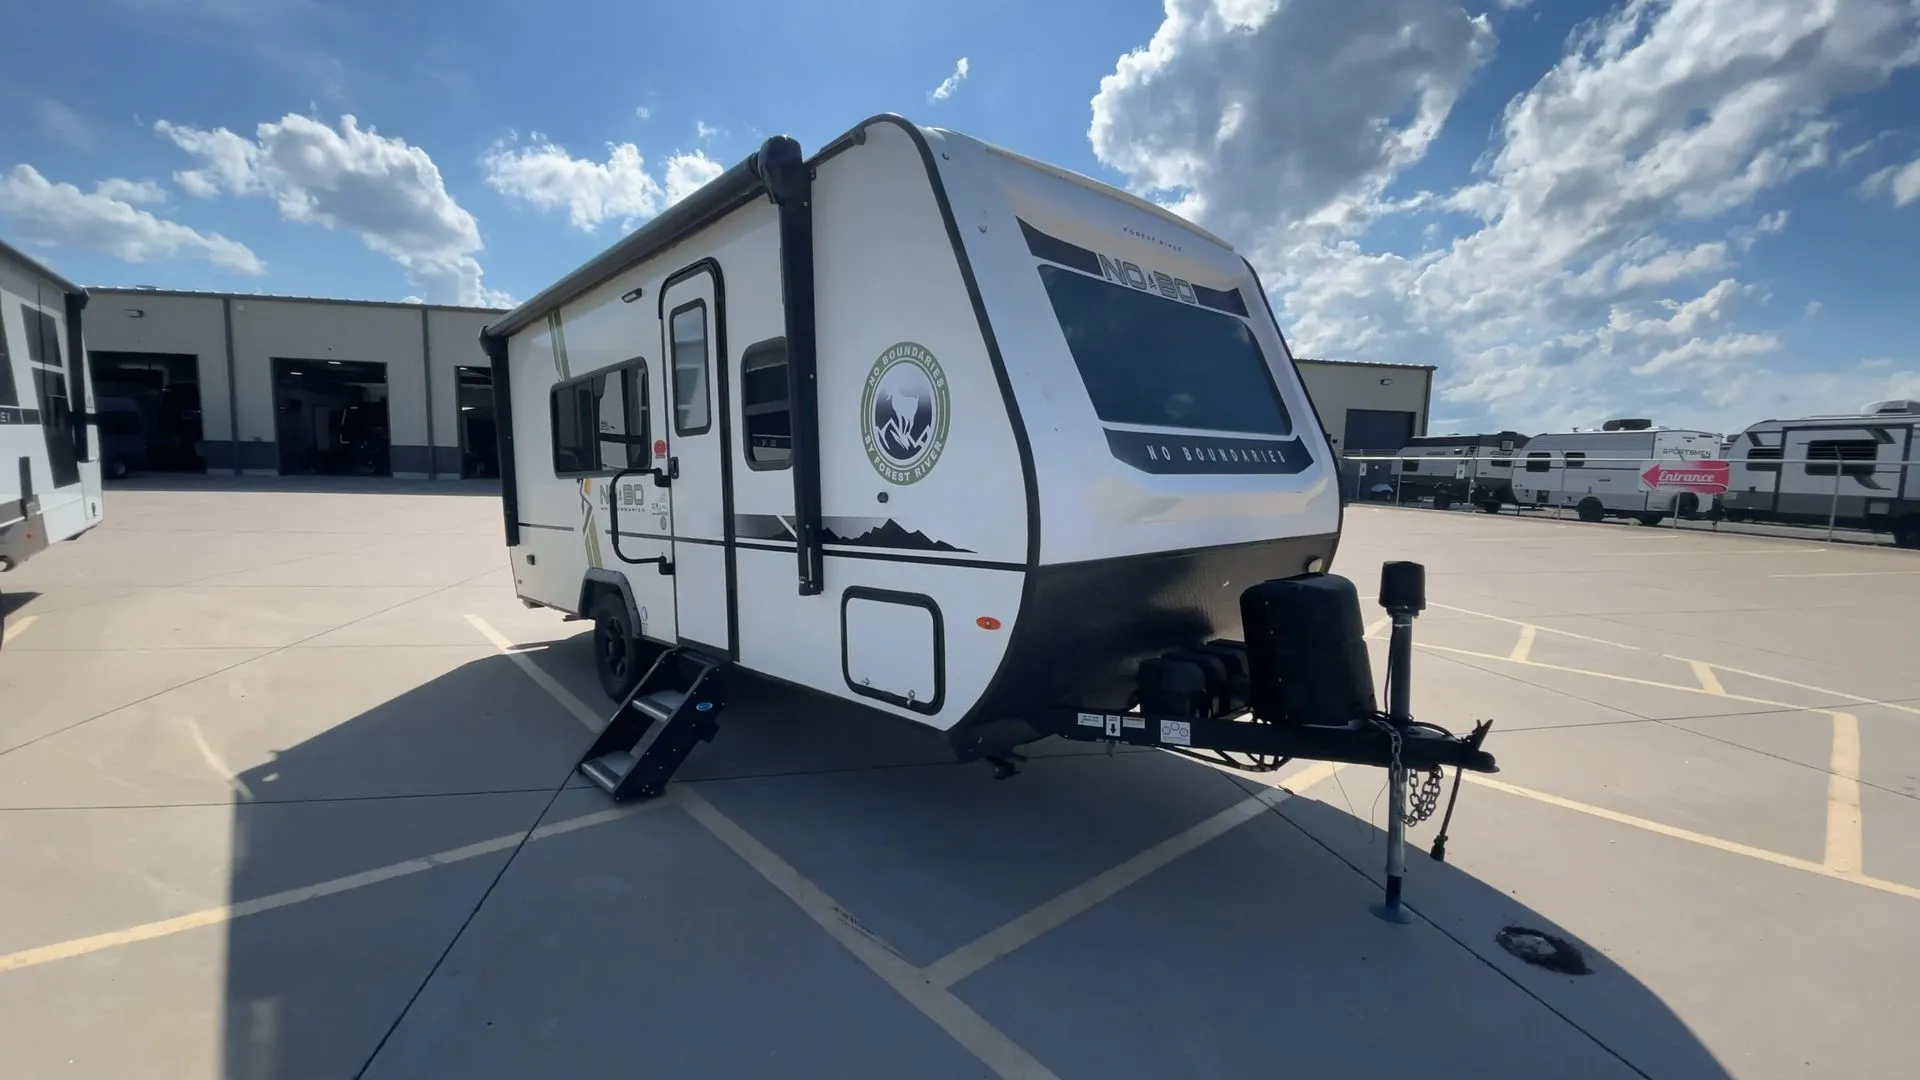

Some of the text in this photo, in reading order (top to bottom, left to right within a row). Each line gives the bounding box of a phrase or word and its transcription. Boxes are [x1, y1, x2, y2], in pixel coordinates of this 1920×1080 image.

[1123, 227, 1182, 252] FOREST RIVER
[868, 345, 945, 388] NO BOUNDARIES
[864, 435, 943, 482] BY FOREST RIVER
[1147, 445, 1286, 463] NO BOUNDARIES
[1659, 471, 1715, 482] Entrance
